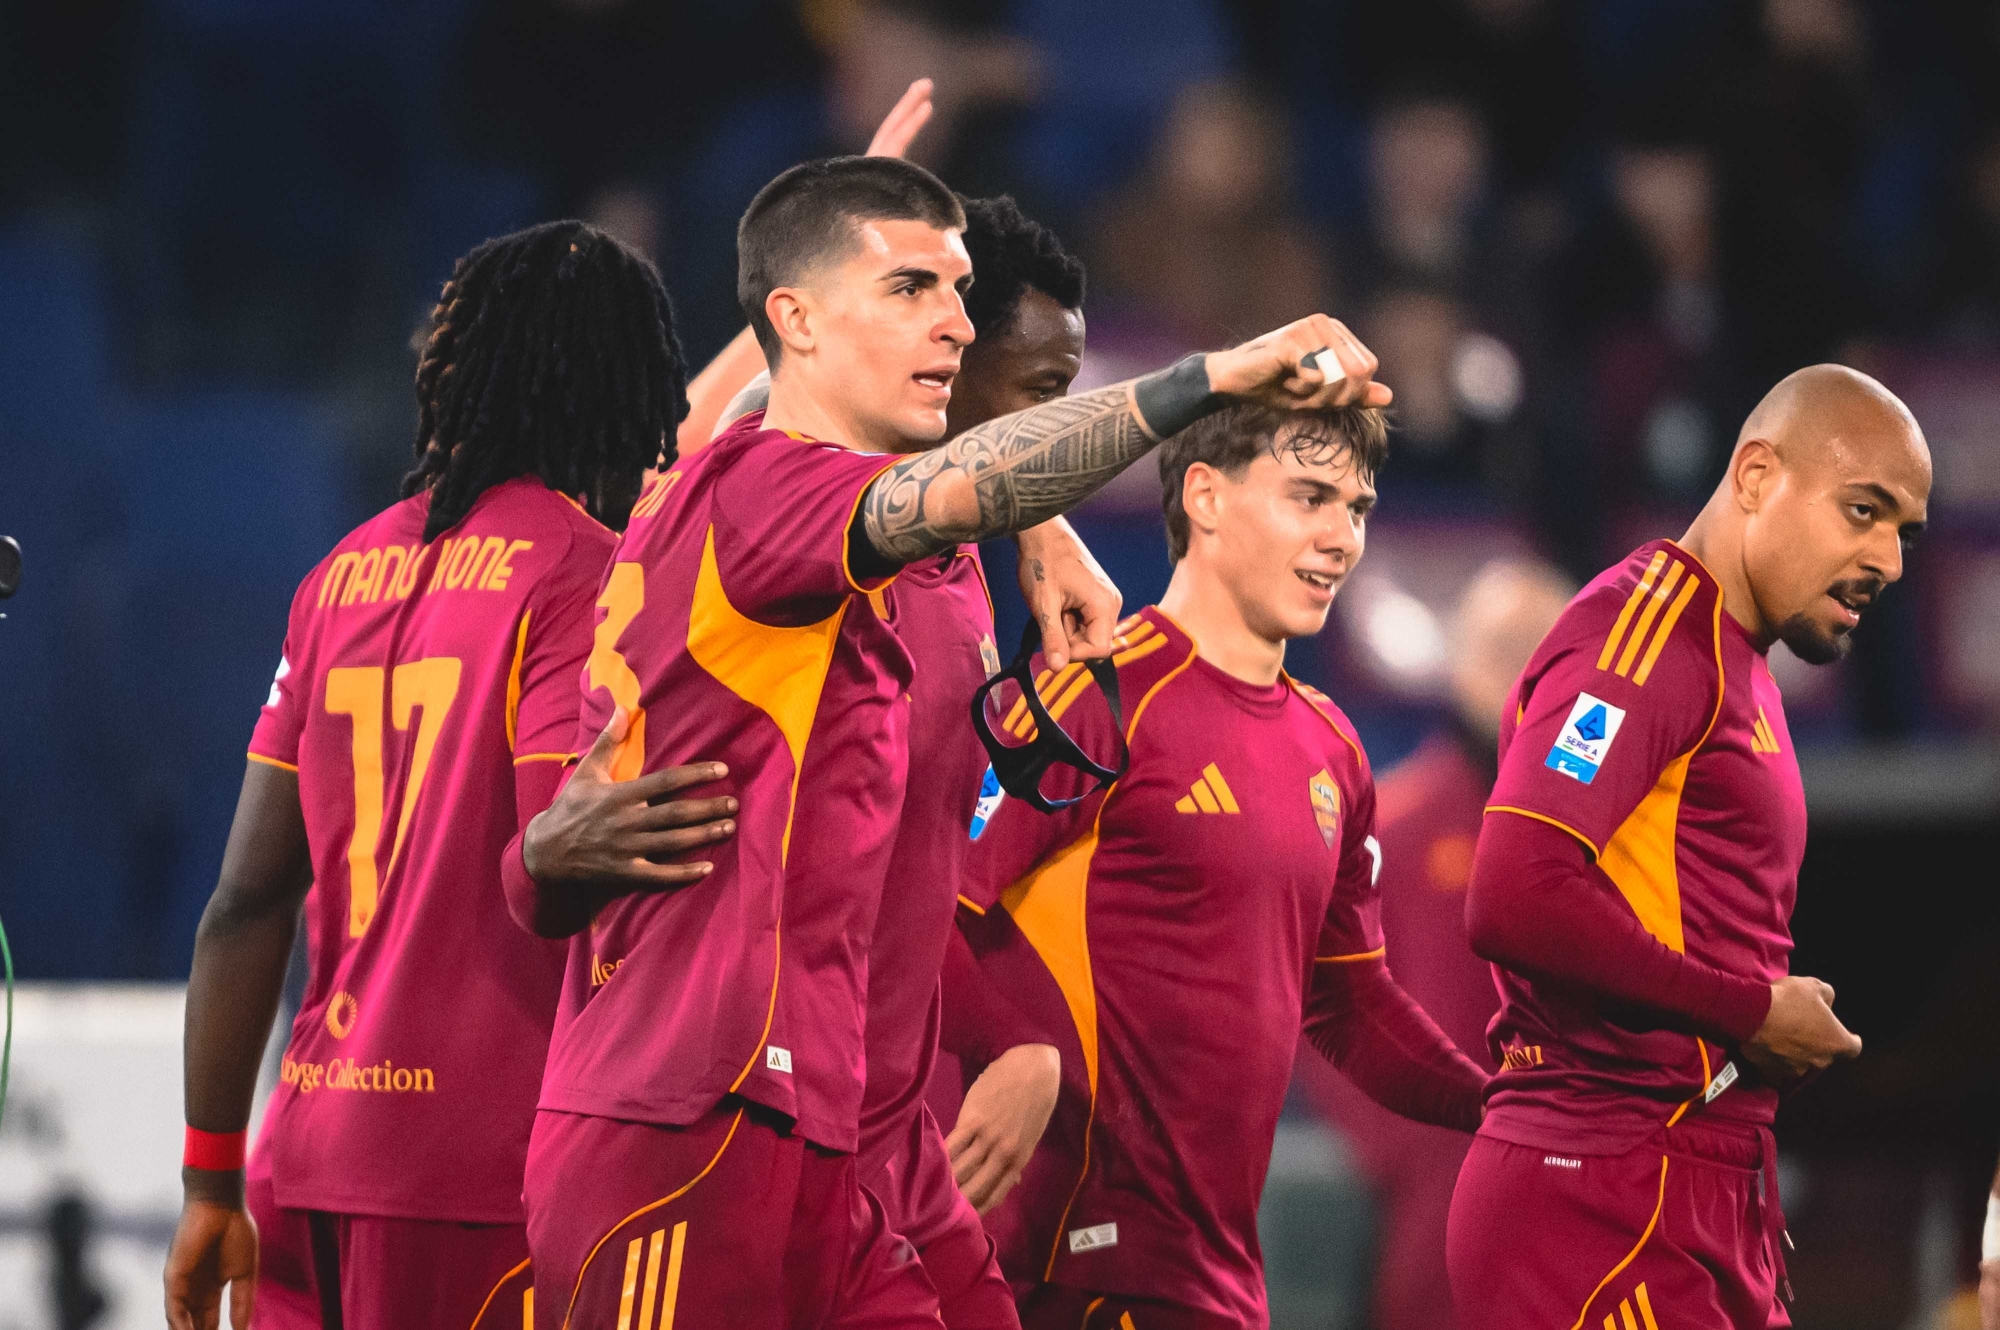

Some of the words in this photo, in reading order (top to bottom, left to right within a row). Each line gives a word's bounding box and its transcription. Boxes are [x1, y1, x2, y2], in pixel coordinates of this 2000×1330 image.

[1565, 735, 1591, 753] SERIE
[1591, 748, 1598, 757] A
[325, 656, 462, 938] 17
[325, 1057, 435, 1092] Collection
